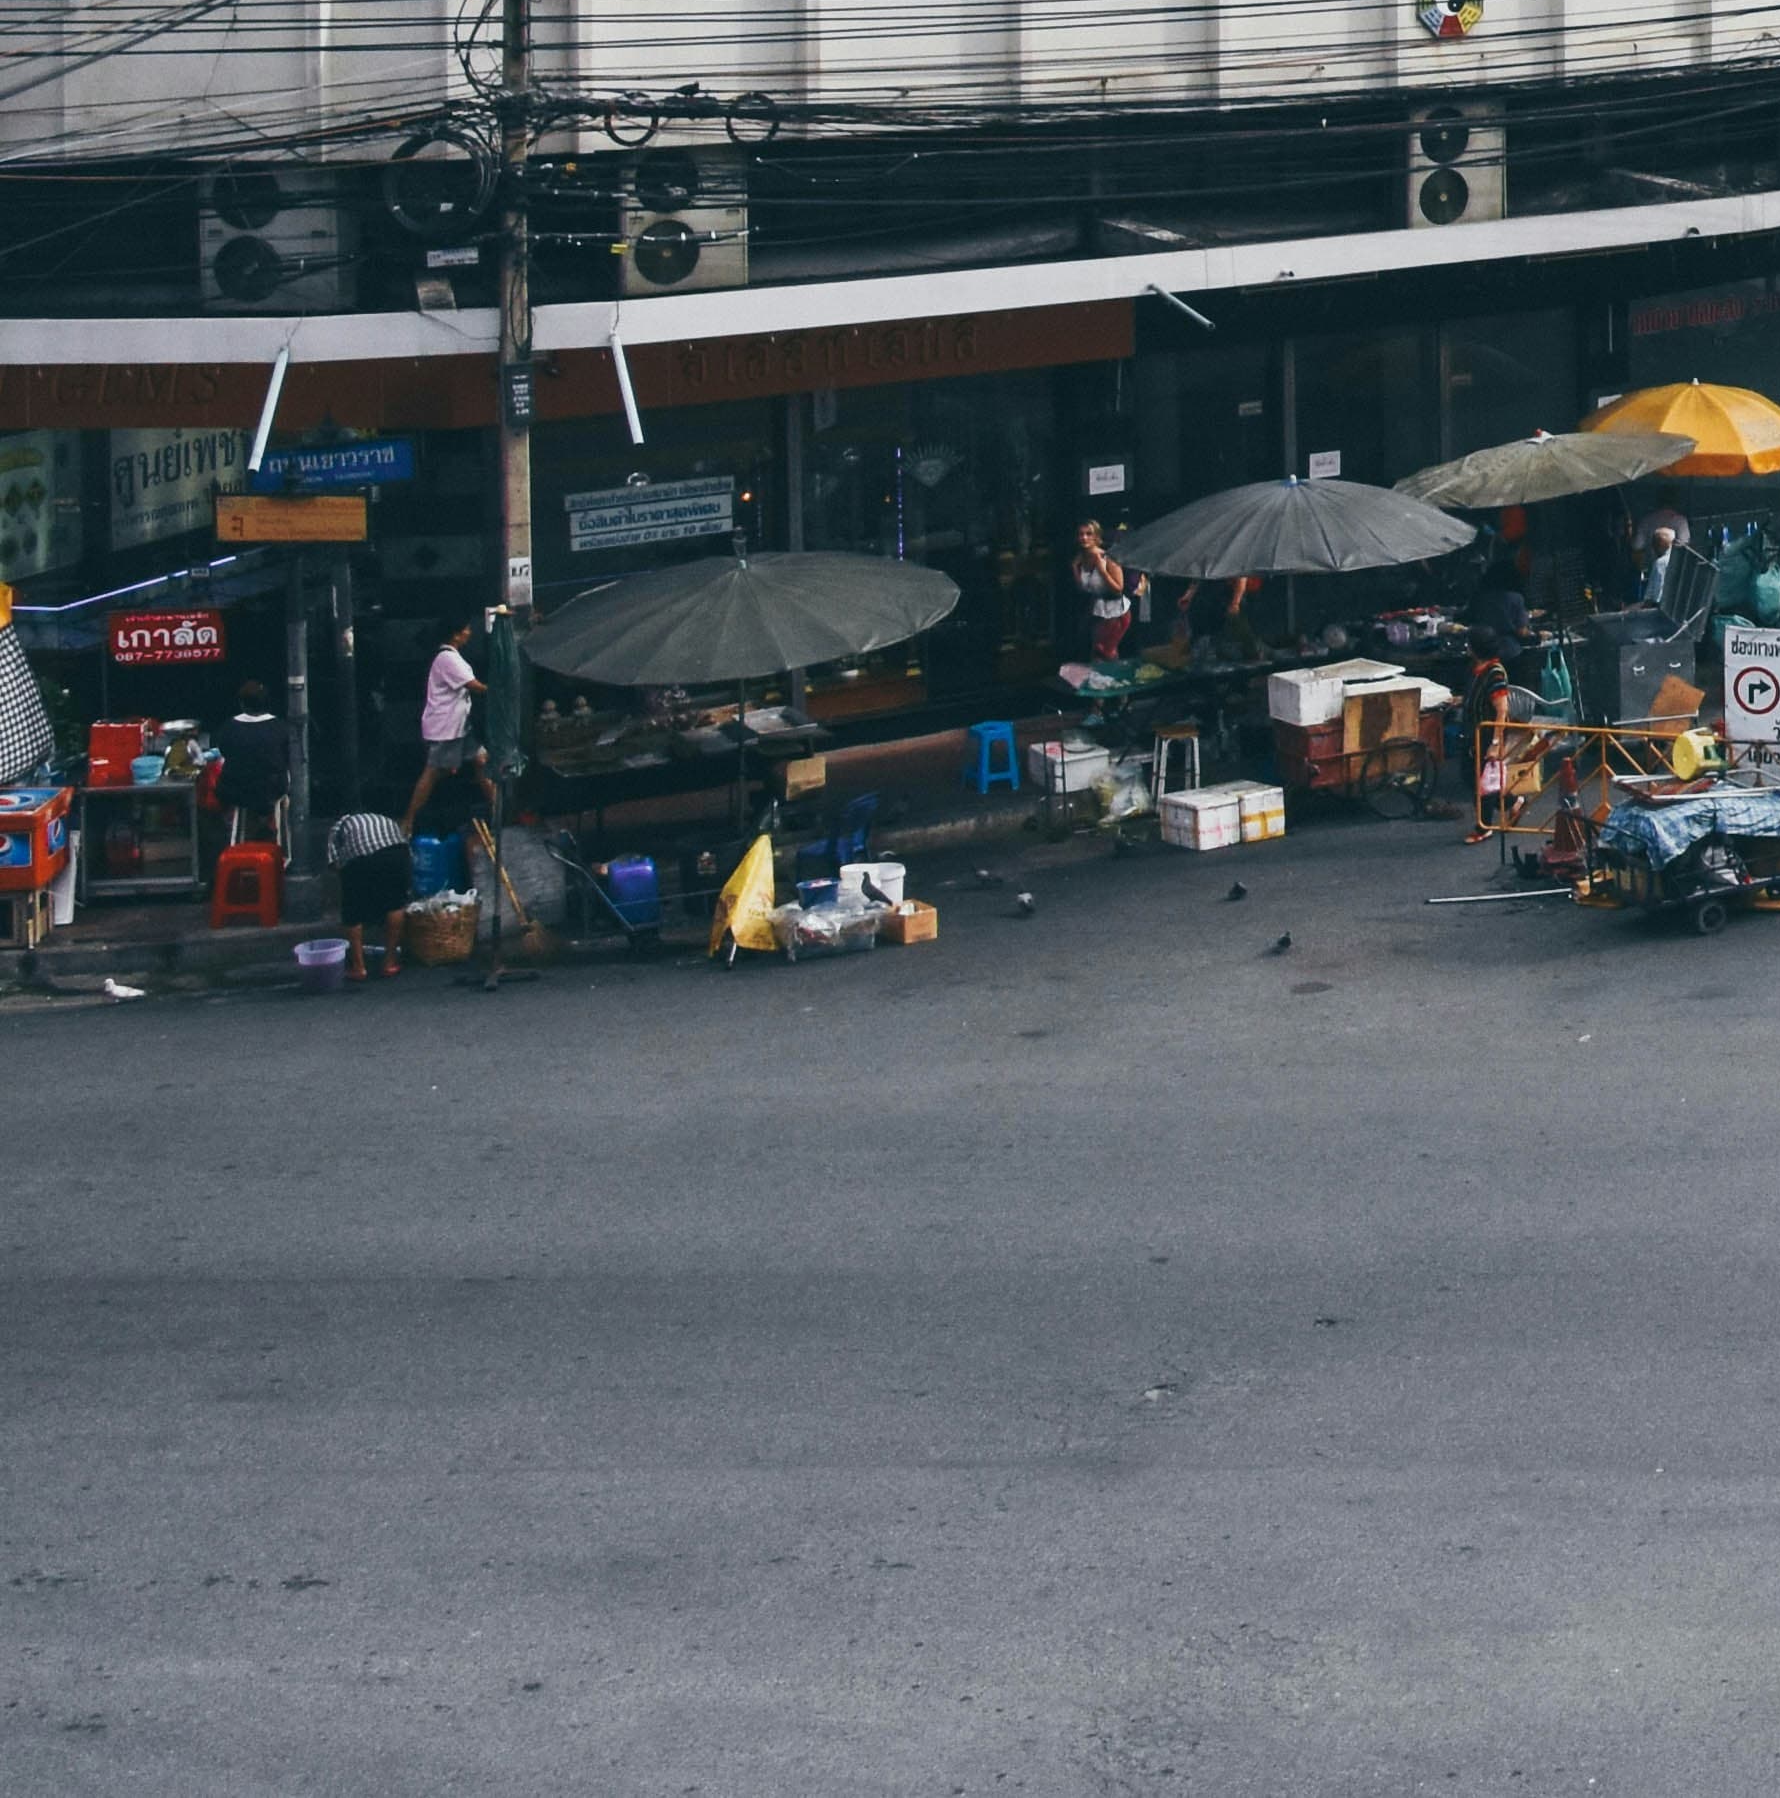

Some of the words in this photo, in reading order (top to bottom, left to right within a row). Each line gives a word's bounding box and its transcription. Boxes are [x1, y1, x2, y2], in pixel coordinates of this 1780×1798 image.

[269, 445, 396, 474] ถนเยาวราช
[117, 620, 218, 649] เกาลัด
